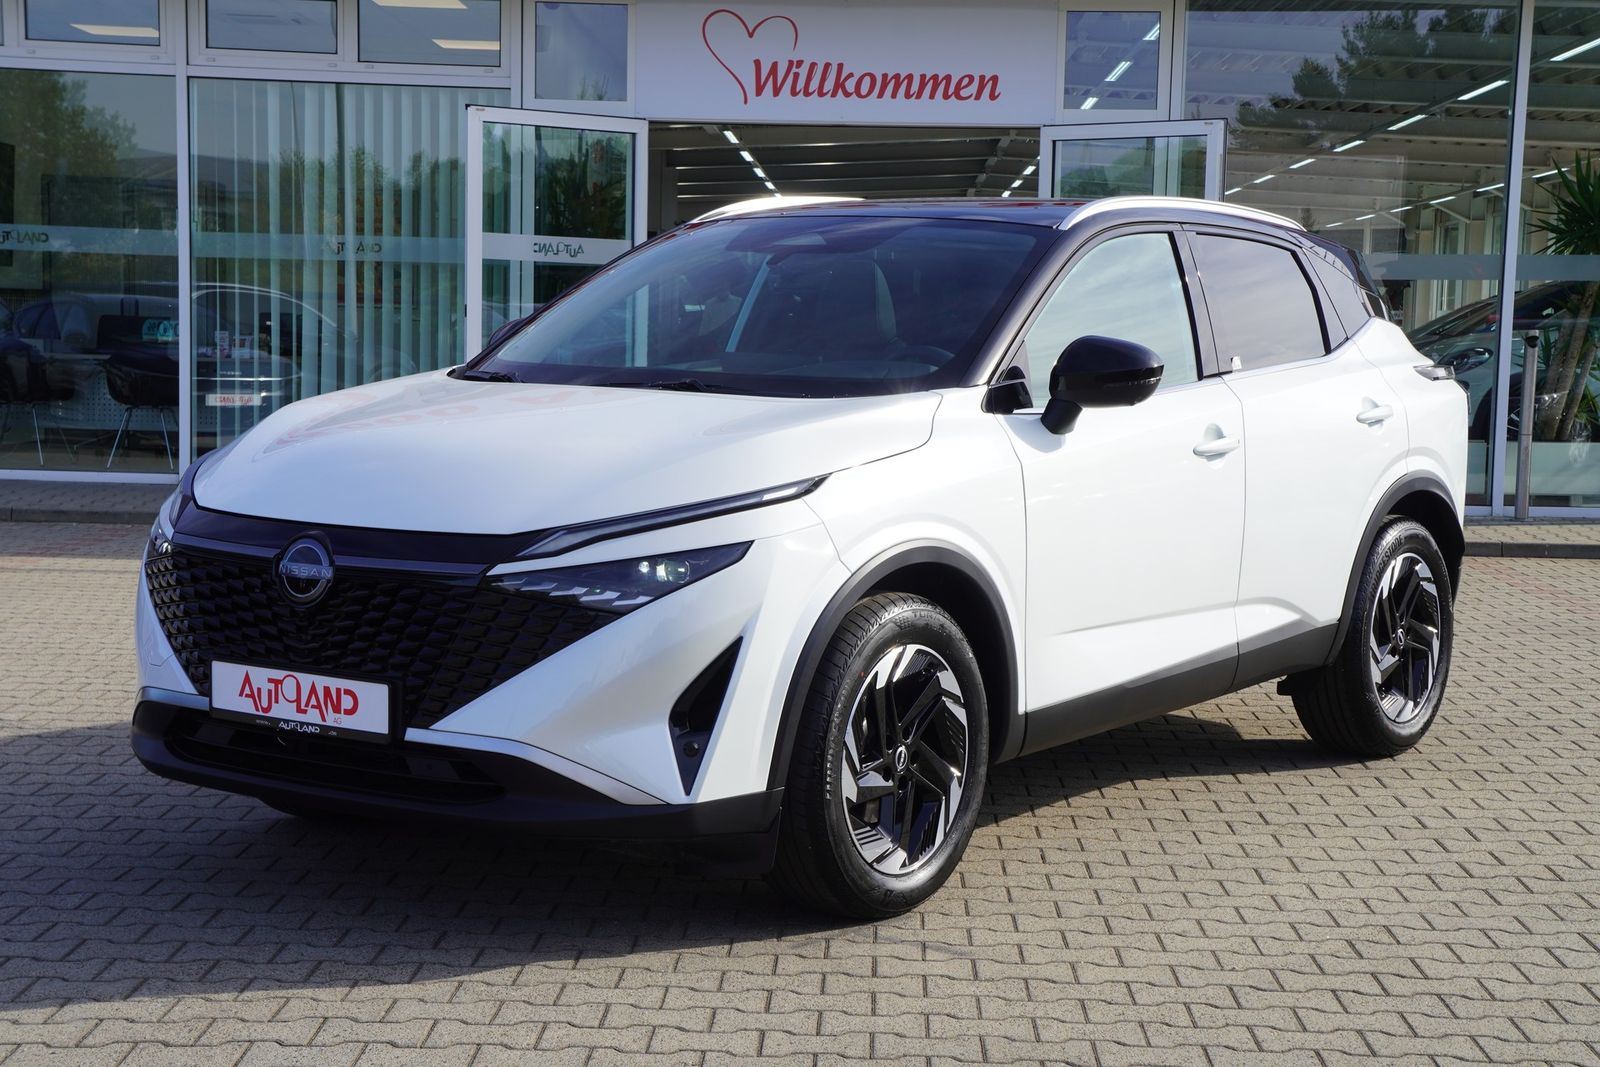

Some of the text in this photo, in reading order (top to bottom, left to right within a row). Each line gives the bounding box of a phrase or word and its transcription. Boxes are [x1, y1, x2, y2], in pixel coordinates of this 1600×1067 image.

[752, 58, 1001, 102] Willkommen
[280, 563, 332, 578] NISSAN
[238, 670, 359, 723] AUTOLAND
[278, 721, 320, 734] AUTOLAND
[333, 717, 342, 725] AG
